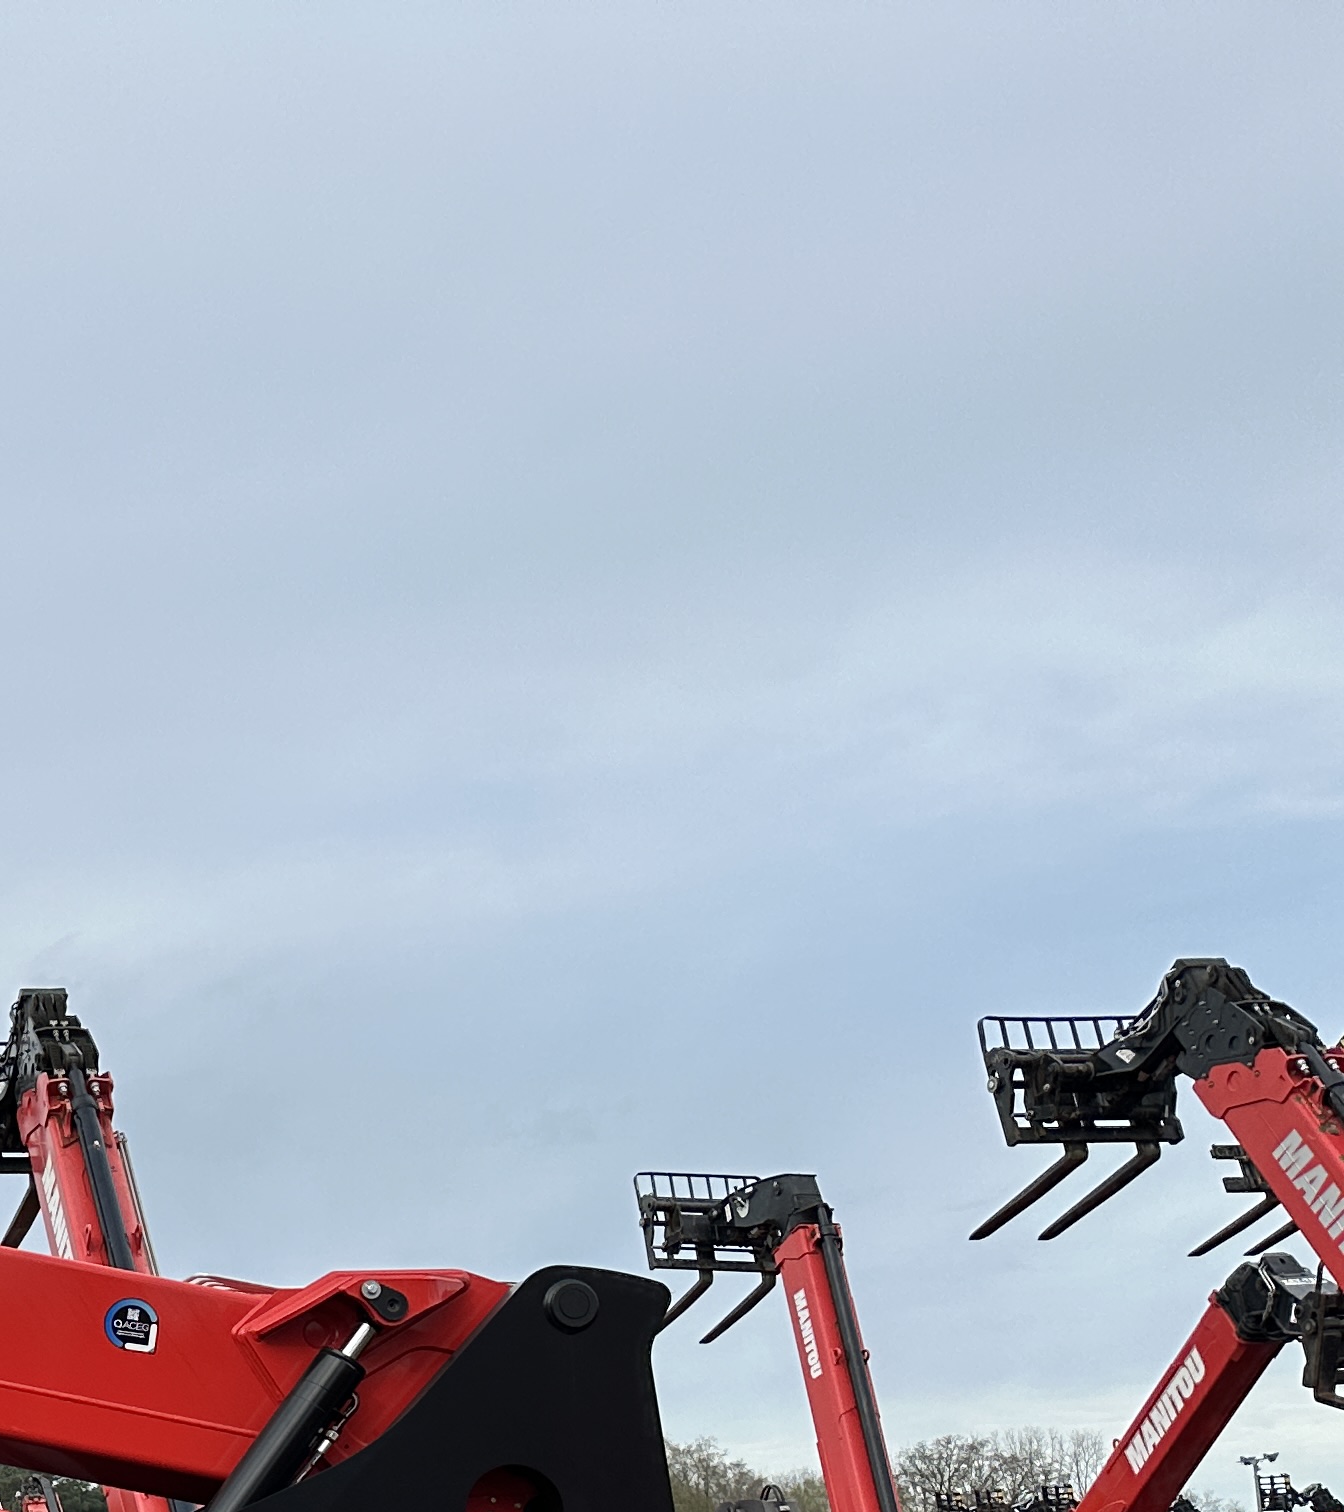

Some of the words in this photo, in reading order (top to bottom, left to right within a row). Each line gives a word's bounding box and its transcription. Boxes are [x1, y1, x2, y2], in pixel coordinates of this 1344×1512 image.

[1272, 1128, 1344, 1256] MAN
[793, 1287, 824, 1379] MANITOU
[1124, 1344, 1206, 1475] MANITOU
